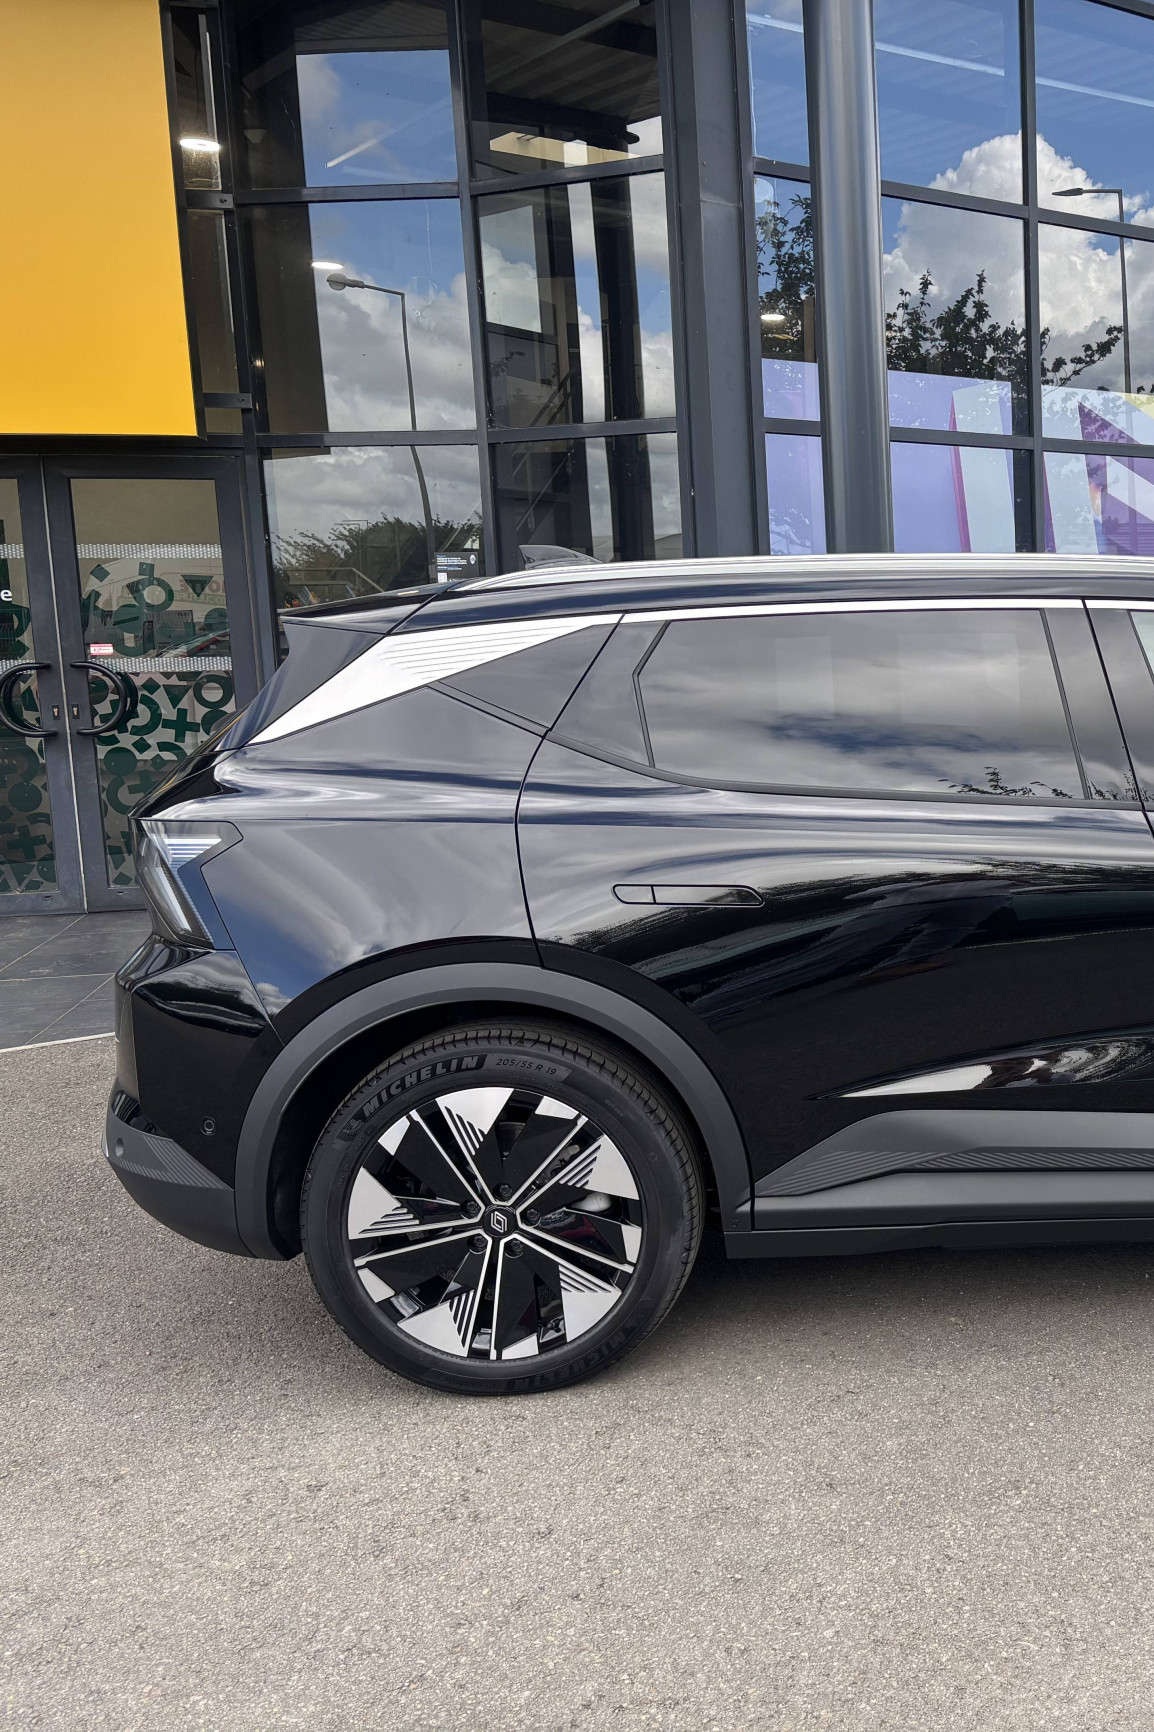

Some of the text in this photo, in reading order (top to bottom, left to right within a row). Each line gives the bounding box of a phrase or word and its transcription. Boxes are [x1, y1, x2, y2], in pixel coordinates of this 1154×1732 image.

[361, 1055, 558, 1118] MICHELIN 205/55 R 19
